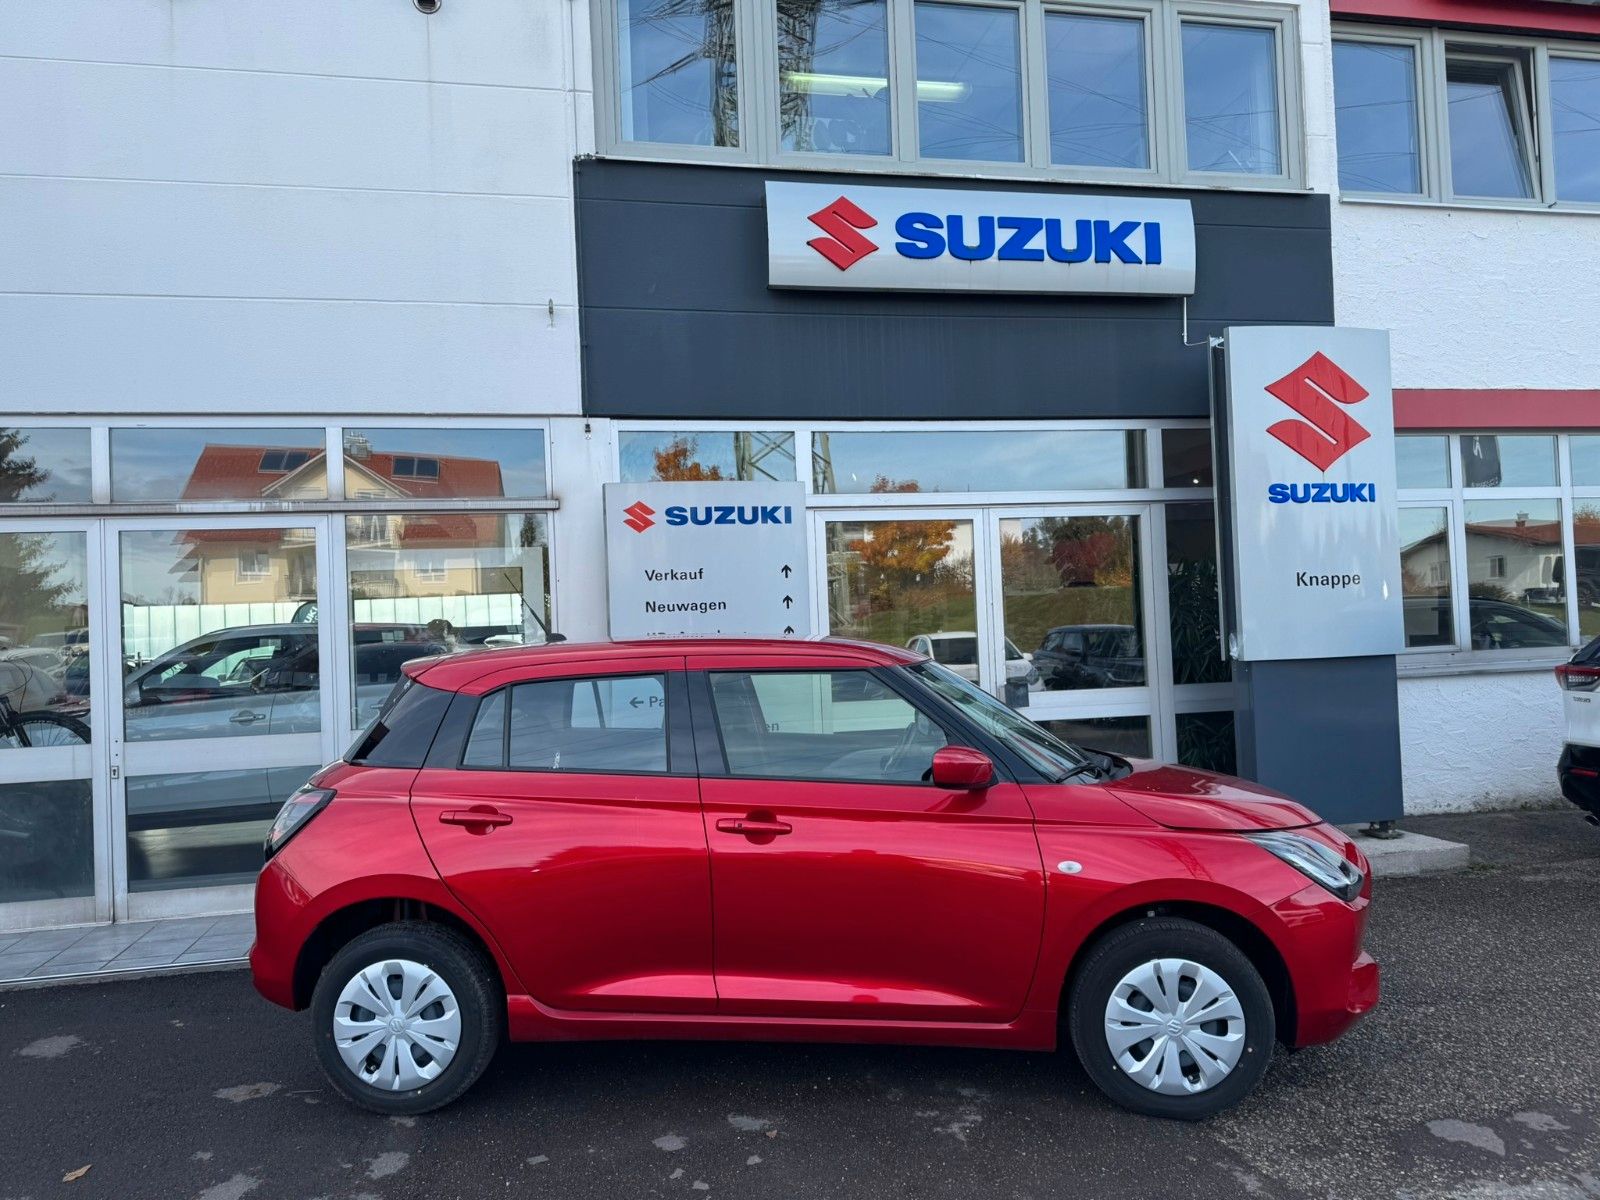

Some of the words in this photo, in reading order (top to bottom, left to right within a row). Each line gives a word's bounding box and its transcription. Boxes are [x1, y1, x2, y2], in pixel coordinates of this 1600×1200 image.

[894, 212, 1163, 266] SUZUKI
[1268, 483, 1375, 503] SUZUKI
[665, 505, 792, 526] SUZUKI
[644, 568, 704, 581] Verkauf
[1296, 571, 1361, 589] Knappe
[645, 601, 727, 613] Neuwagen
